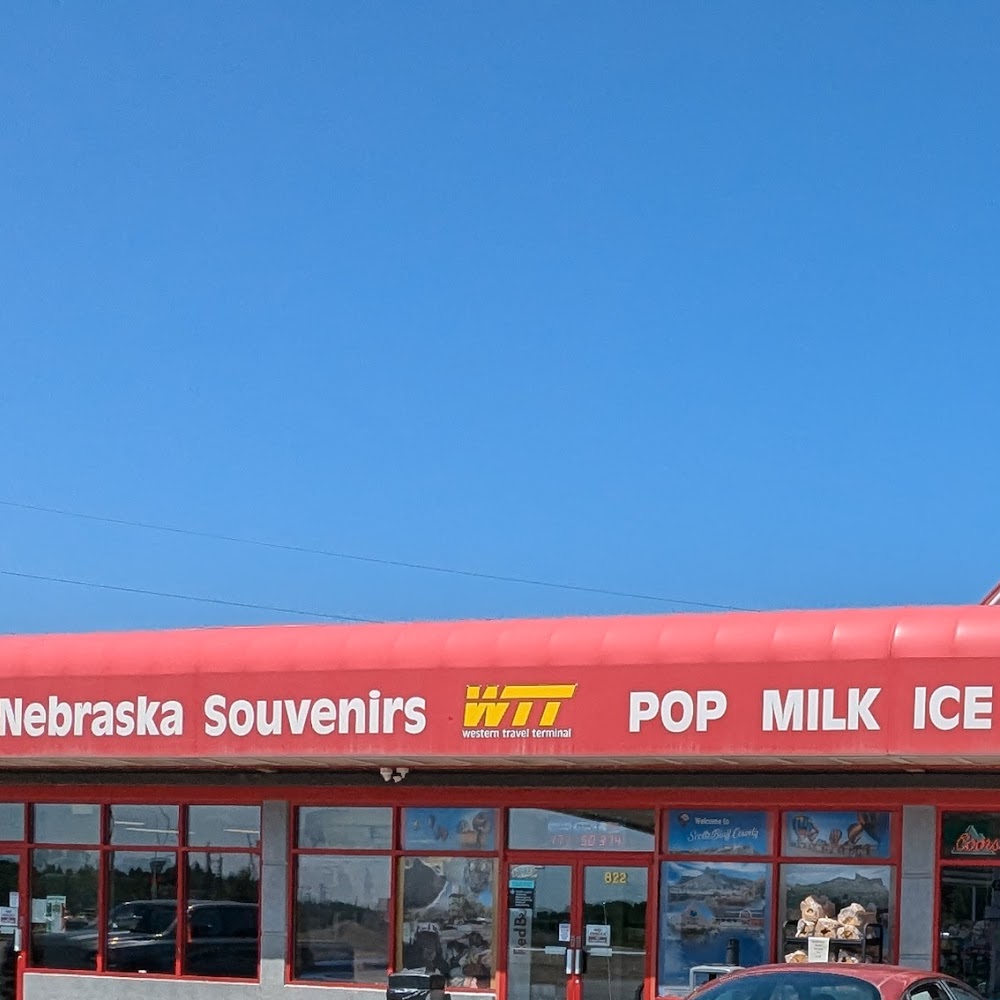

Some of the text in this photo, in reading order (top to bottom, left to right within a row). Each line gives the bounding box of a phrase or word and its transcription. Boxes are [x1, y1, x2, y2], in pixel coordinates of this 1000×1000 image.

[0, 690, 427, 737] Nebraska Souvenirs
[464, 684, 578, 727] WTT
[629, 690, 727, 732] POP
[762, 688, 881, 731] MILK
[913, 686, 993, 730] ICE
[462, 728, 572, 738] western travel terminal
[694, 817, 722, 825] Welcome
[955, 833, 1000, 852] Coors
[604, 872, 628, 884] 822
